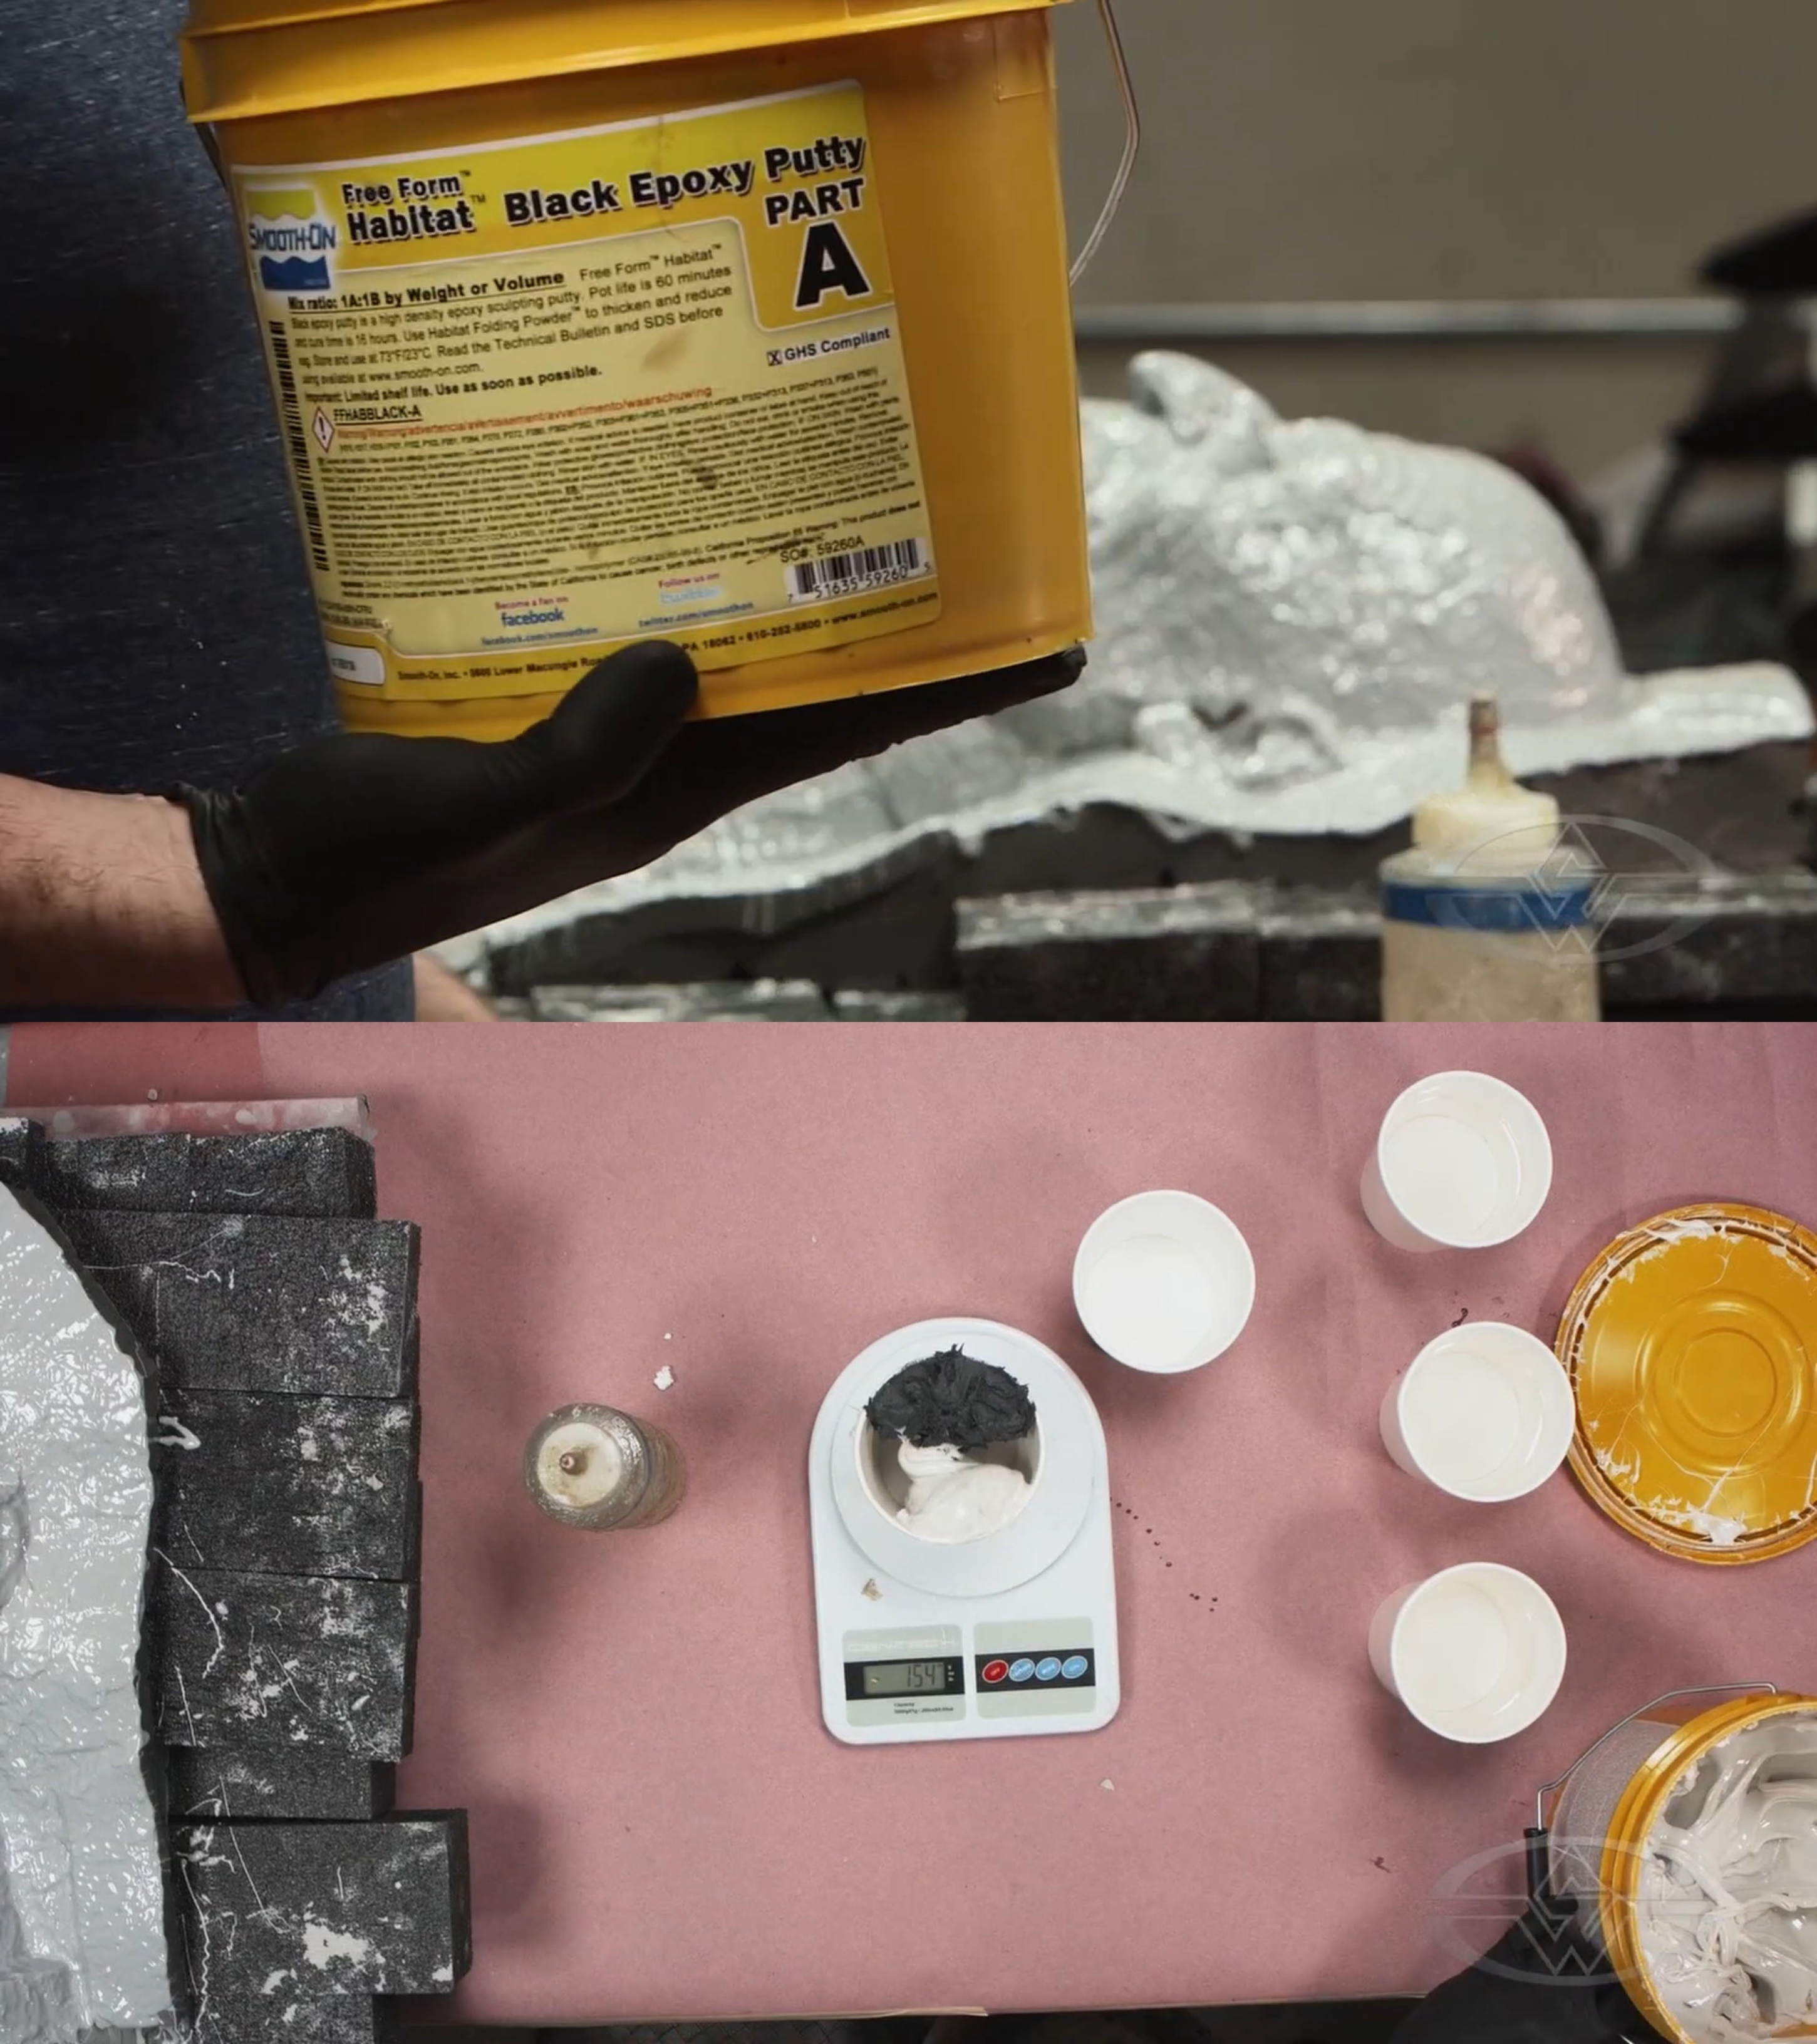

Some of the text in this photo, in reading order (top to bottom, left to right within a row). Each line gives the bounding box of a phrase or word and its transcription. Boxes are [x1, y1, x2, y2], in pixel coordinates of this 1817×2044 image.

[342, 183, 392, 205] Free
[504, 137, 864, 225] Black Epoxy Putty
[765, 178, 863, 225] PART
[249, 222, 335, 251] SMOOTH-ON
[795, 222, 871, 309] A
[288, 296, 305, 309] Mix
[307, 296, 337, 309] ratio:
[341, 292, 380, 307] 1A:1B
[385, 291, 402, 307] by
[406, 284, 465, 303] Weight
[471, 284, 488, 296] or
[493, 273, 564, 291] Volume
[579, 268, 611, 281] Free
[378, 314, 401, 327] high
[405, 309, 443, 322] density
[448, 304, 482, 318] epoxy
[487, 296, 544, 313] sculpting
[589, 286, 611, 299] Pot
[616, 282, 636, 294] life
[641, 280, 652, 291] is
[656, 274, 673, 287] 60
[678, 267, 732, 284] minutes
[403, 330, 425, 342] Use
[428, 324, 470, 340] Habitat
[473, 320, 519, 334] Folding
[585, 308, 599, 319] to
[602, 299, 651, 317] thicken
[655, 293, 681, 307] and
[685, 286, 732, 302] reduce
[437, 344, 468, 358] Read
[472, 342, 492, 354] the
[495, 333, 557, 351] Technical
[560, 325, 611, 342] Bulletin
[614, 320, 640, 334] and
[644, 314, 675, 329] SDS
[679, 306, 723, 323] before
[785, 344, 817, 361] GHS
[821, 328, 891, 353] Compliant
[382, 387, 408, 401] shelf
[411, 385, 433, 398] life.
[435, 384, 458, 396] Use
[463, 382, 477, 393] as
[482, 378, 515, 391] soon
[518, 375, 534, 386] as
[538, 366, 603, 386] possible.
[333, 405, 422, 421] FFHABBLACK-A
[815, 577, 858, 599] 51635
[866, 565, 908, 587] 59260
[502, 607, 564, 627] facebook
[907, 1664, 936, 1688] 154
